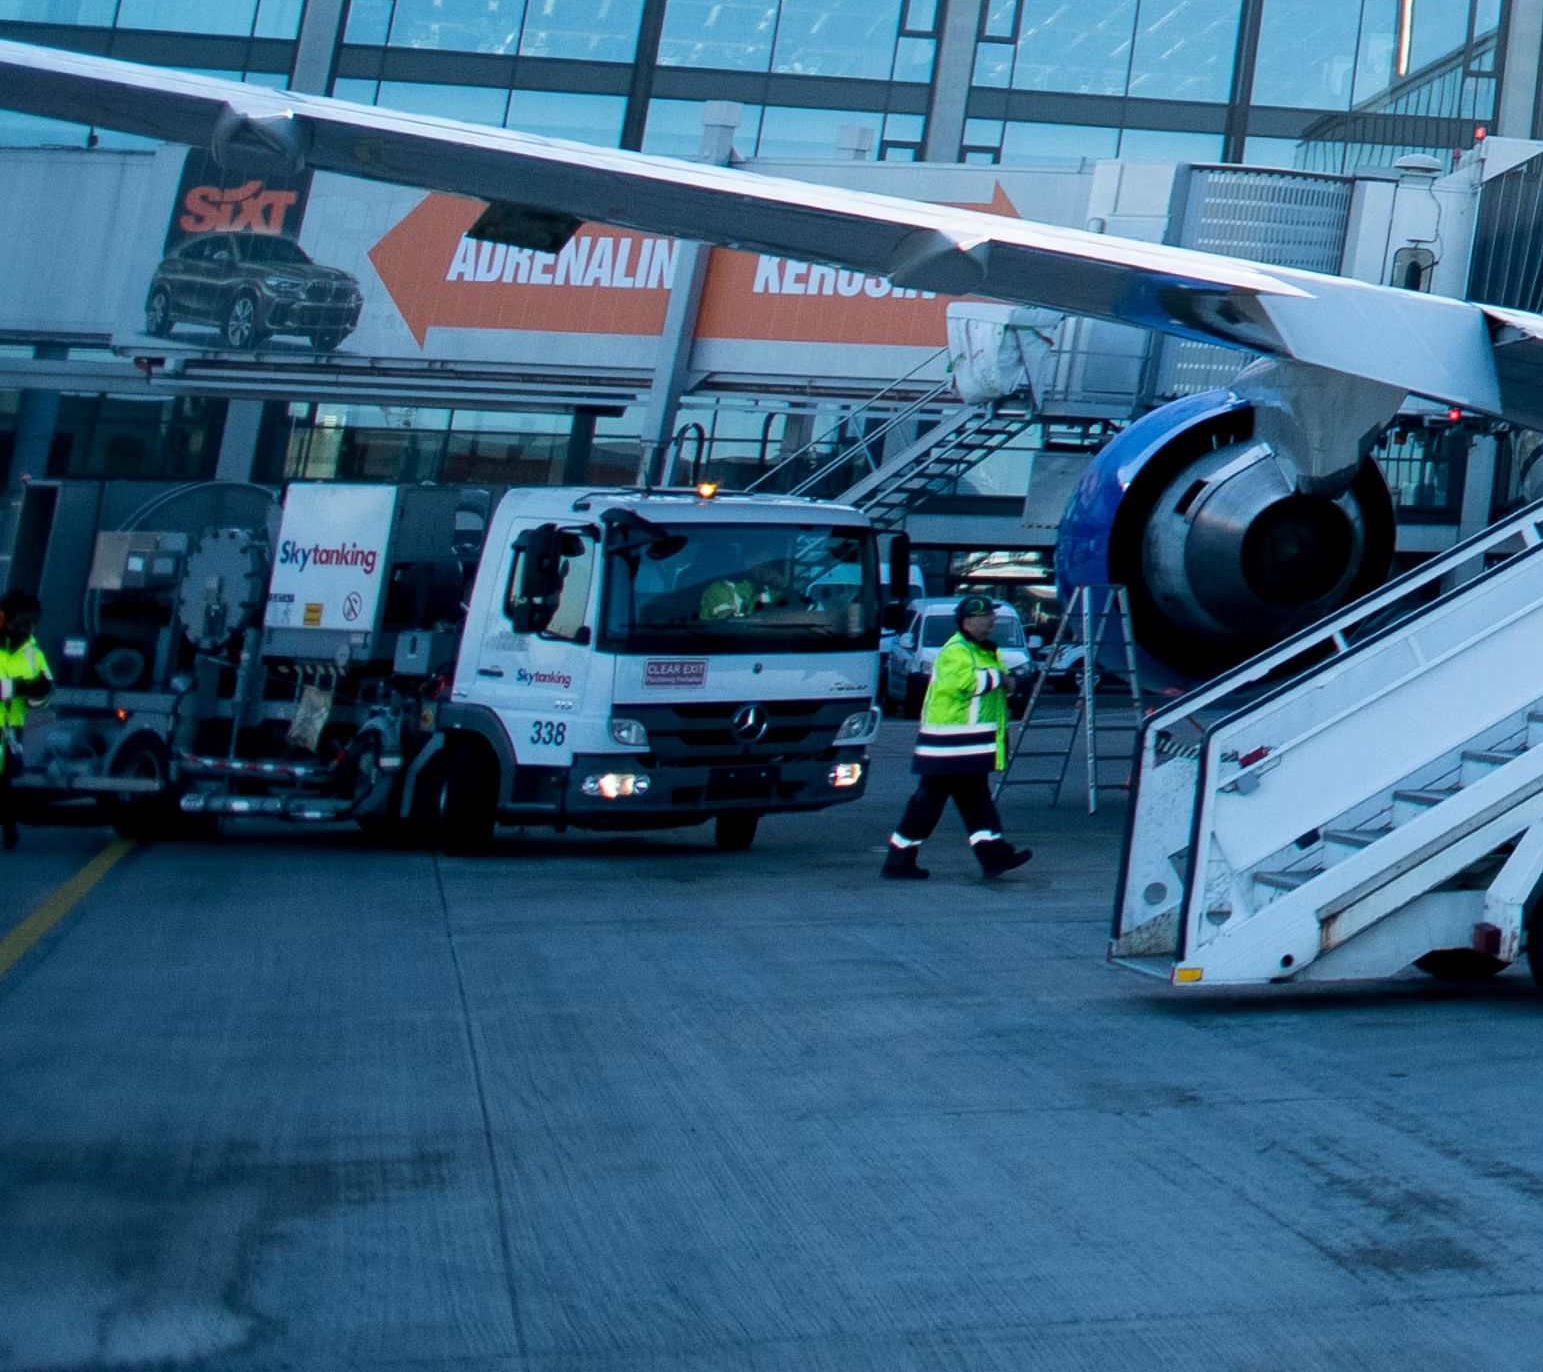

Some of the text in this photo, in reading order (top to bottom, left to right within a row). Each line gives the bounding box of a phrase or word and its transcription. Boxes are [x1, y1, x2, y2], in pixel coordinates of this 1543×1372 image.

[280, 540, 377, 574] Skytanking
[516, 668, 572, 688] Skytanking
[648, 664, 704, 674] CLEAR EXIT
[531, 720, 566, 746] 338
